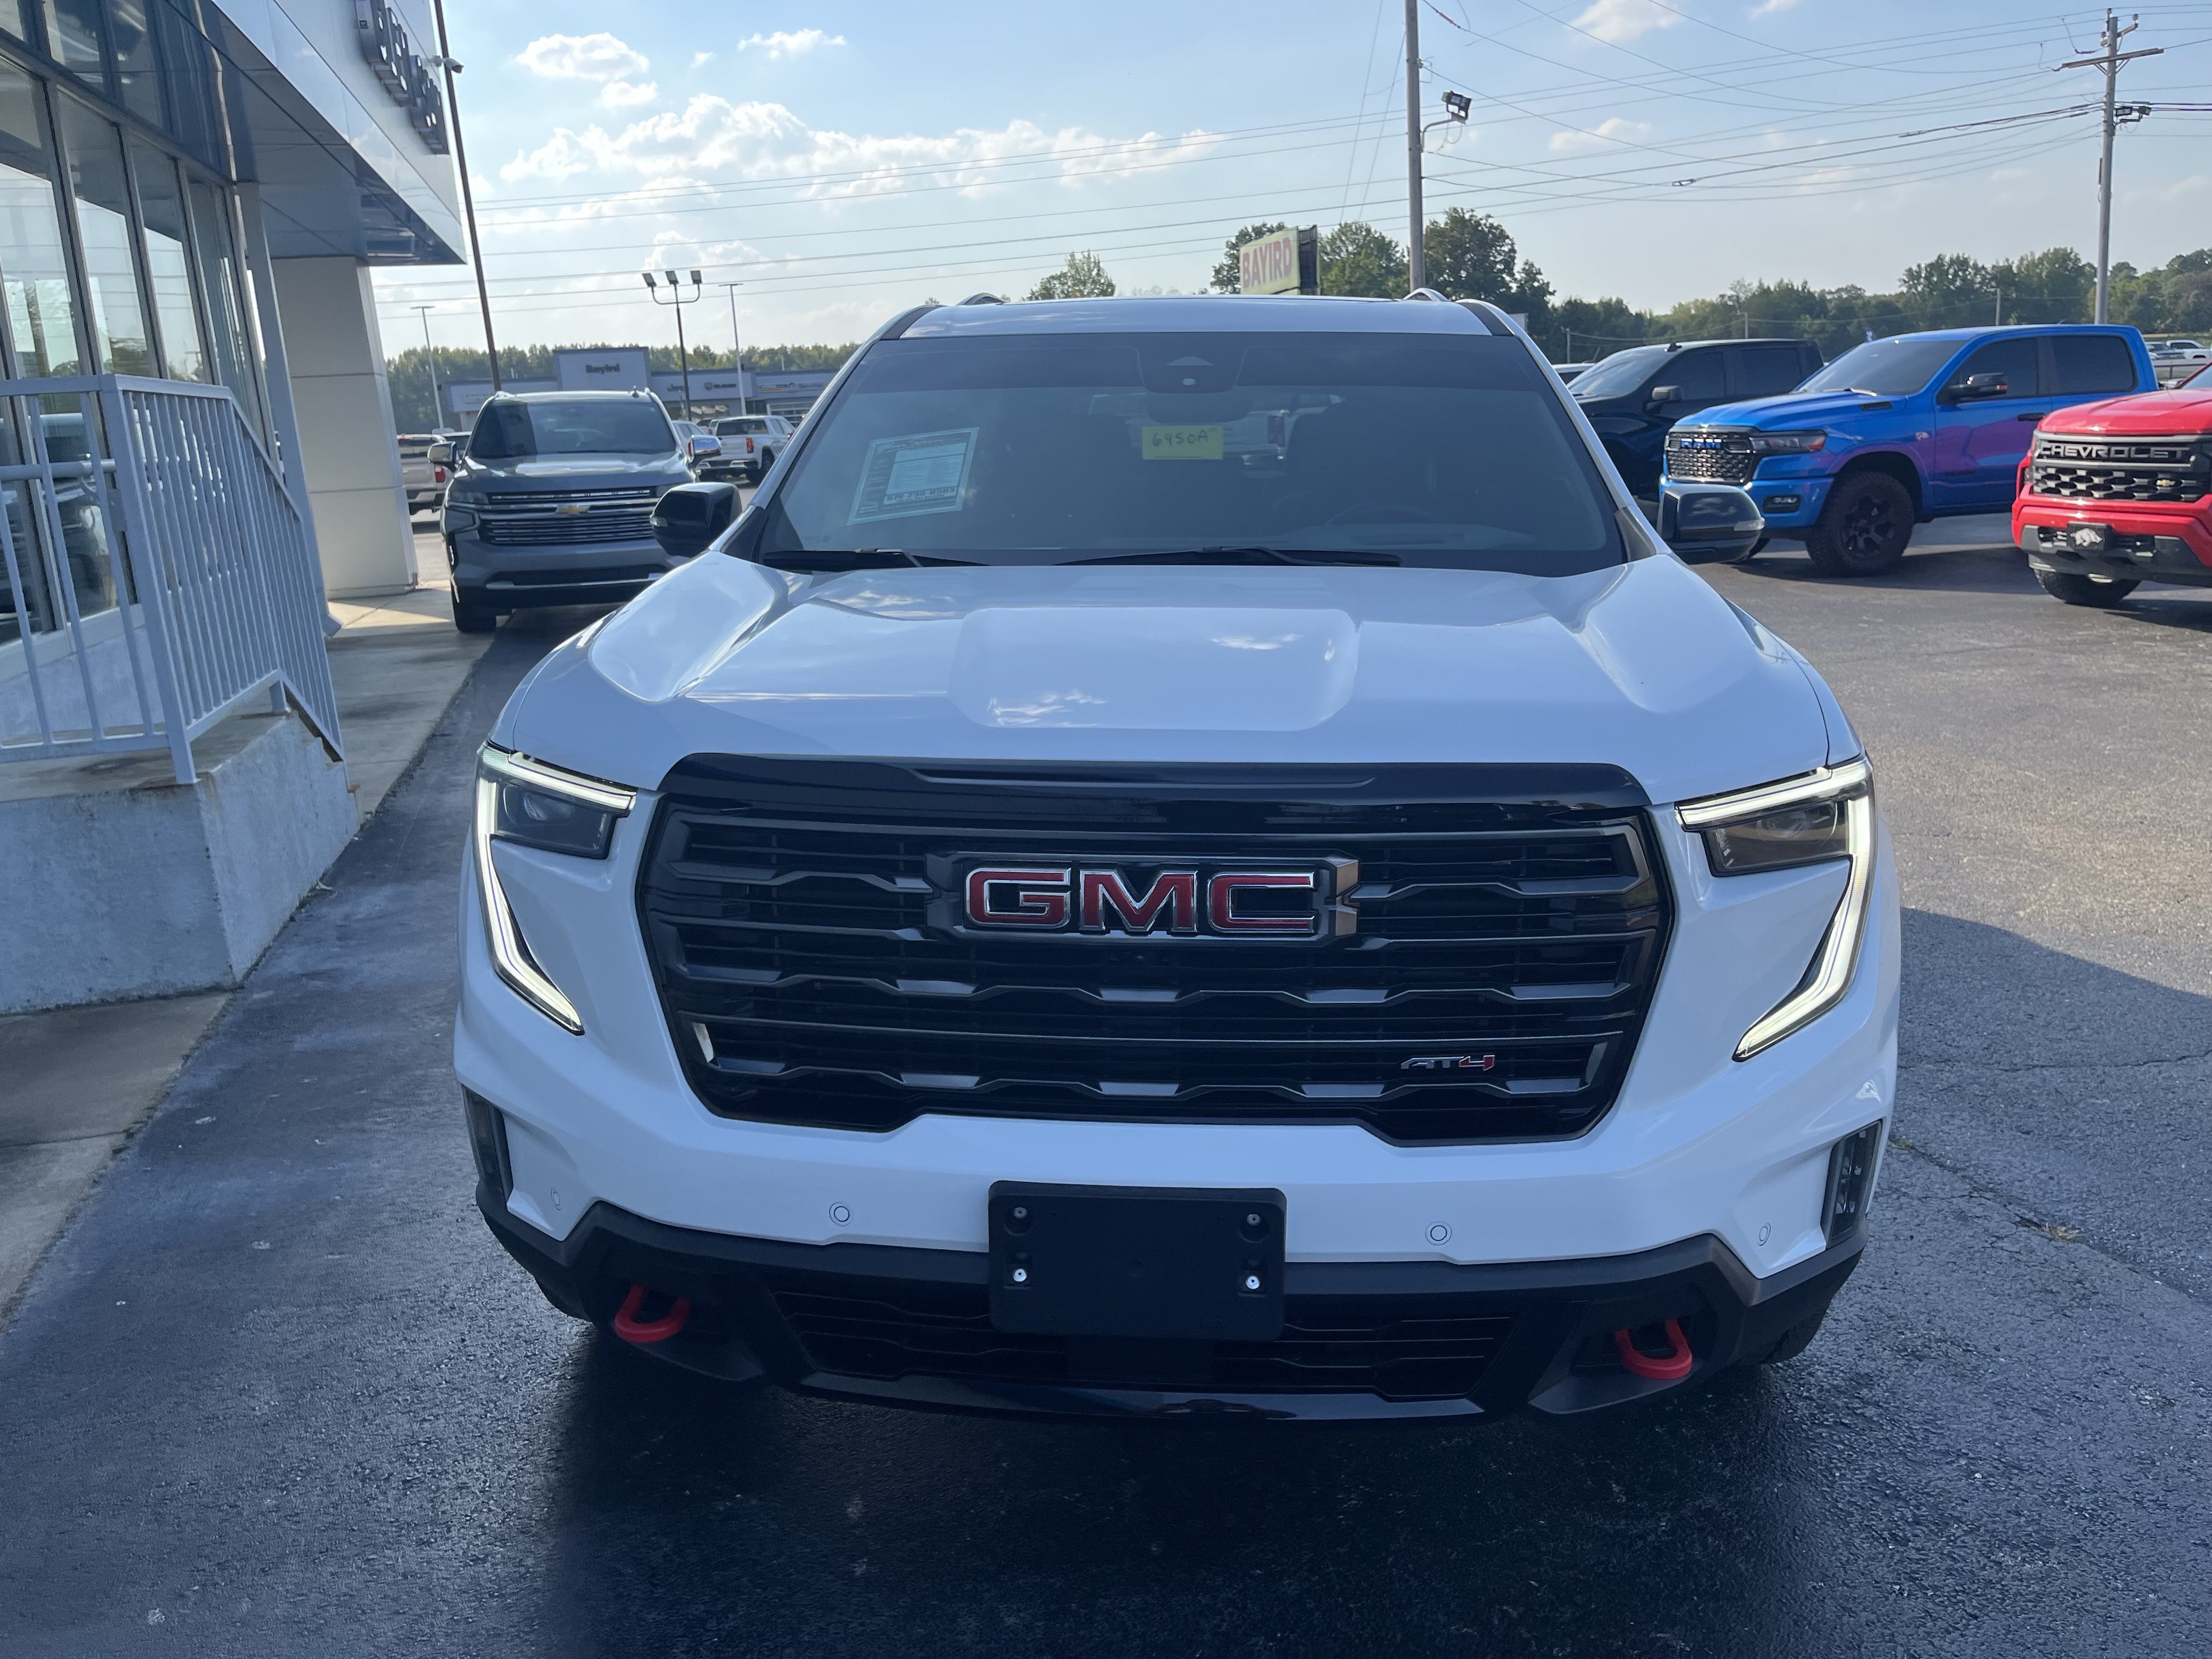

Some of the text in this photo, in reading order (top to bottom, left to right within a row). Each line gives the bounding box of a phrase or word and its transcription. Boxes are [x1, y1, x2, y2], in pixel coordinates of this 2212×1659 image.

[1242, 237, 1292, 289] BAYIRD
[1681, 438, 1722, 449] RAM
[2040, 441, 2191, 458] CHEVROLET
[965, 867, 1317, 934] GMC
[1401, 1054, 1496, 1071] AT4
